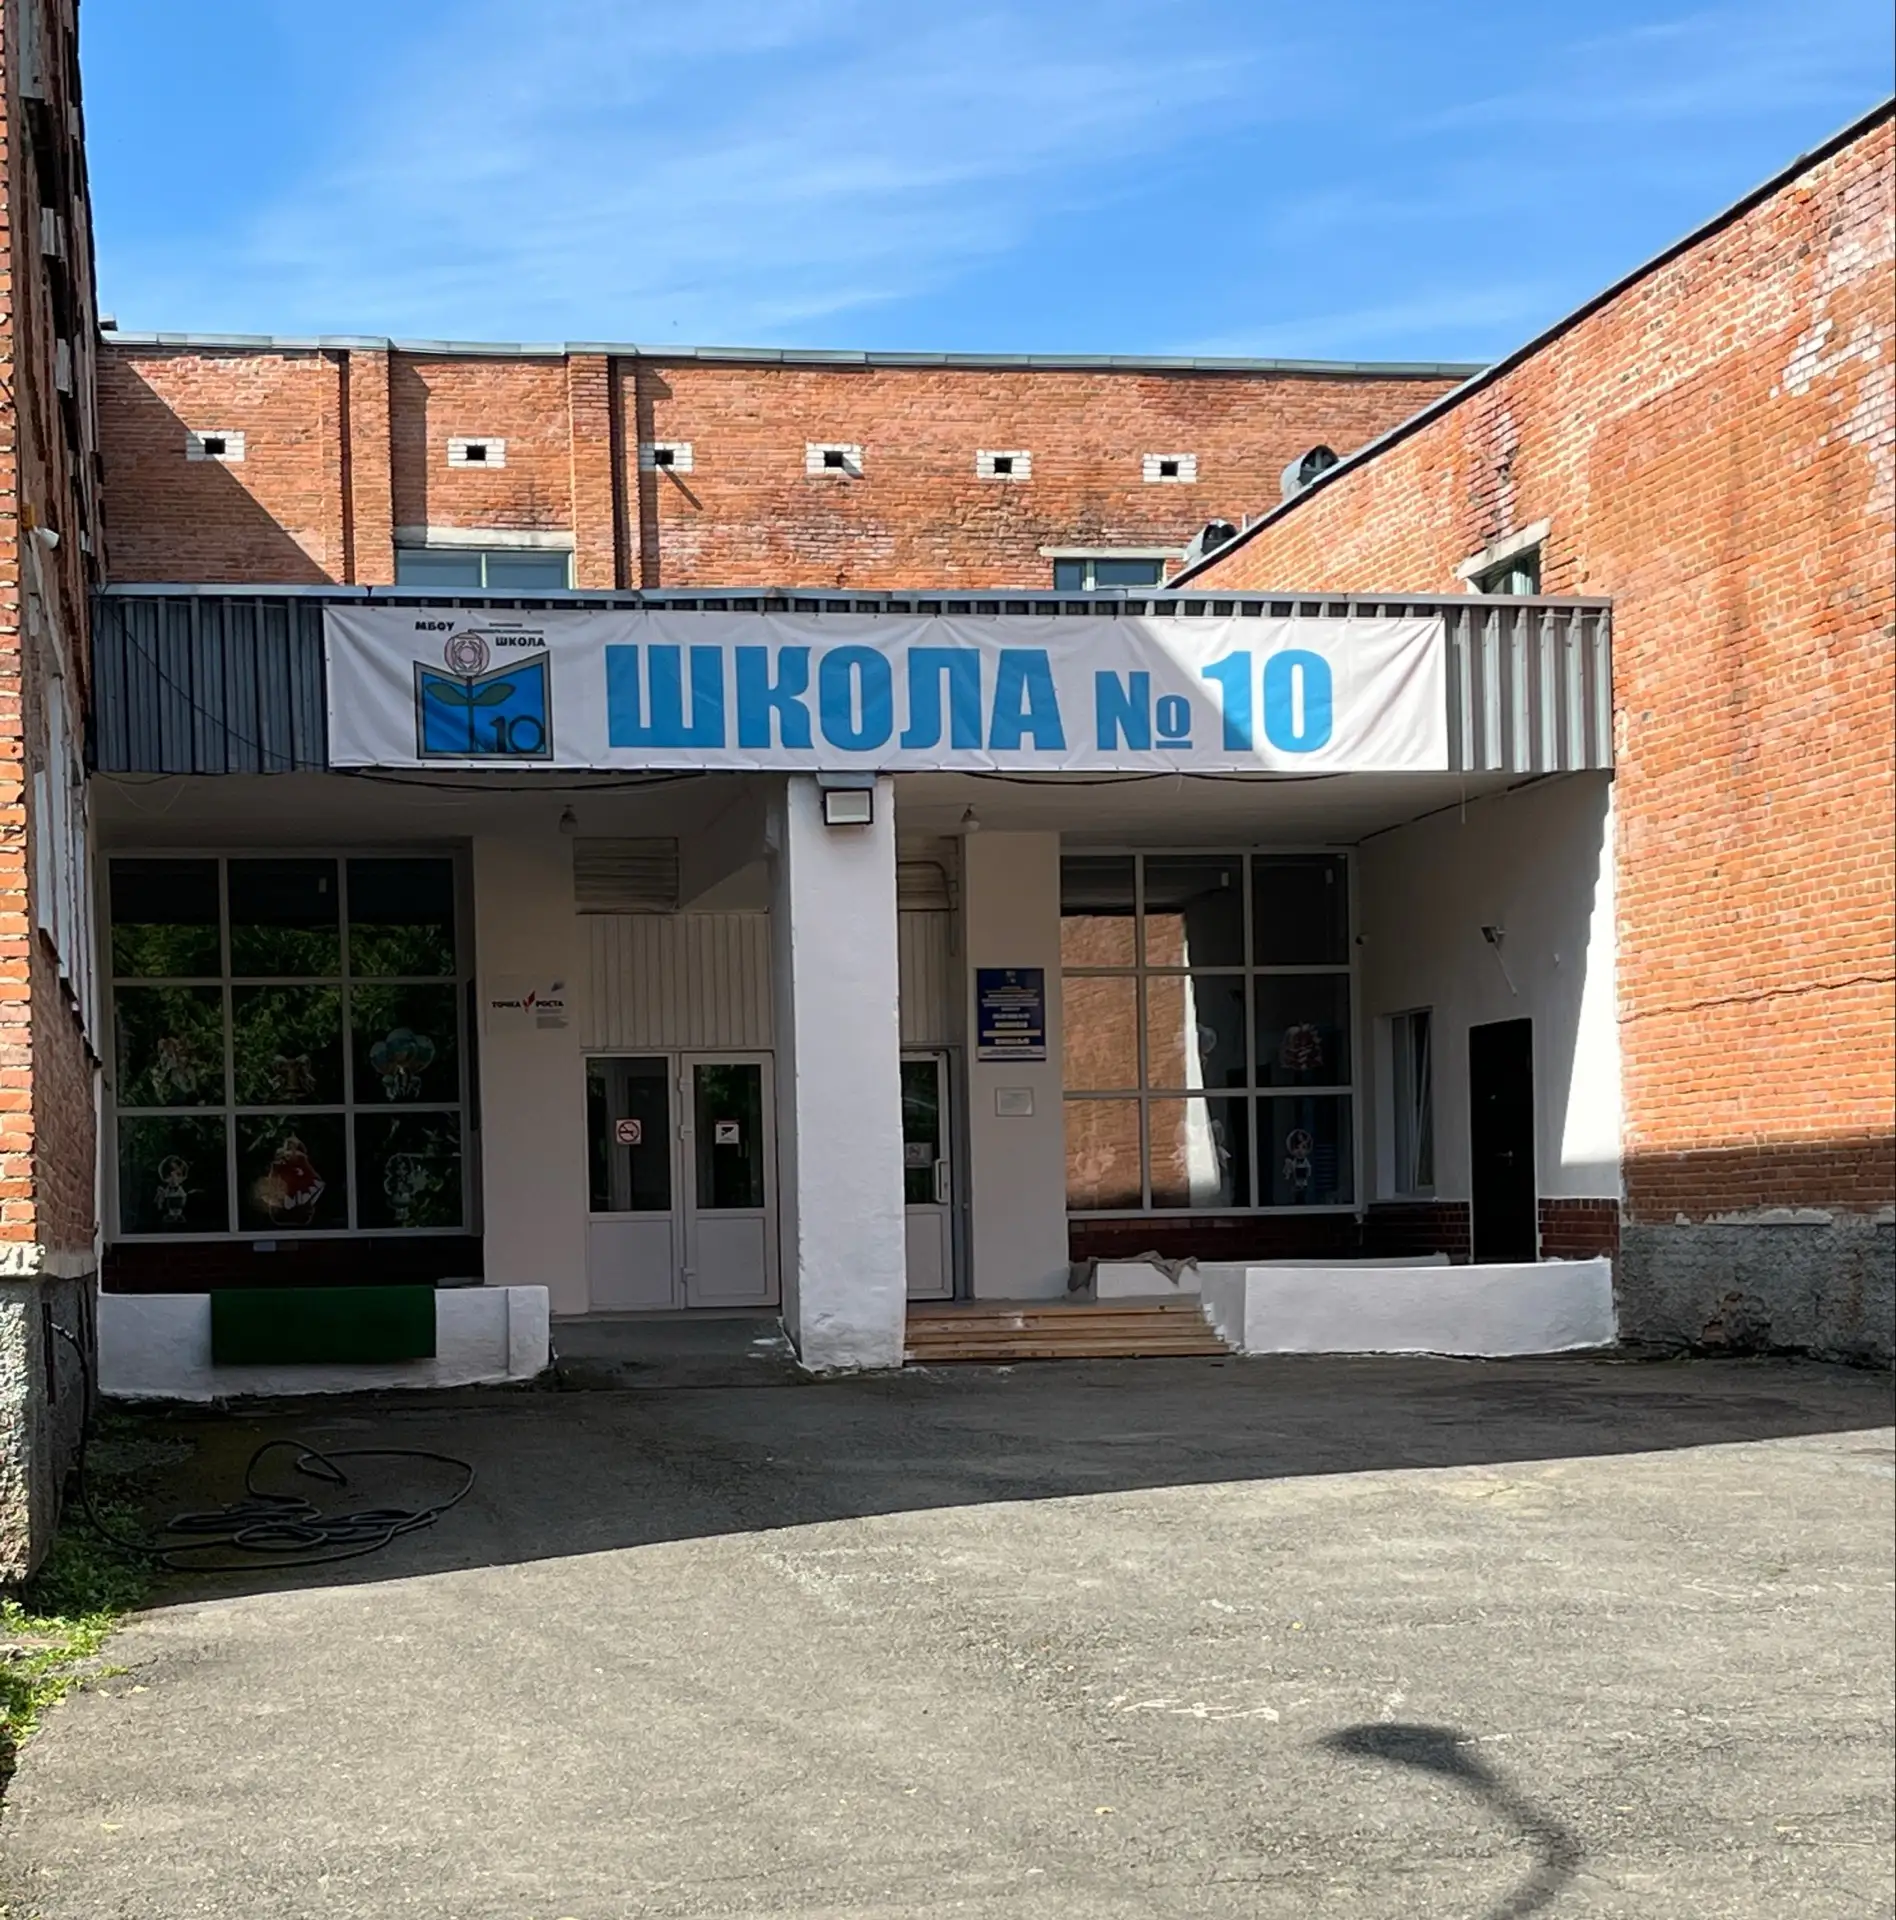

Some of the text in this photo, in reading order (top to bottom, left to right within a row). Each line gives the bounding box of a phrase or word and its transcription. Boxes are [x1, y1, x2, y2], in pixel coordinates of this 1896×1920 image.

[415, 621, 454, 631] МБОУ
[495, 636, 546, 646] ШКОЛА
[605, 644, 1333, 753] ШКОЛА № 10
[490, 715, 545, 752] 10
